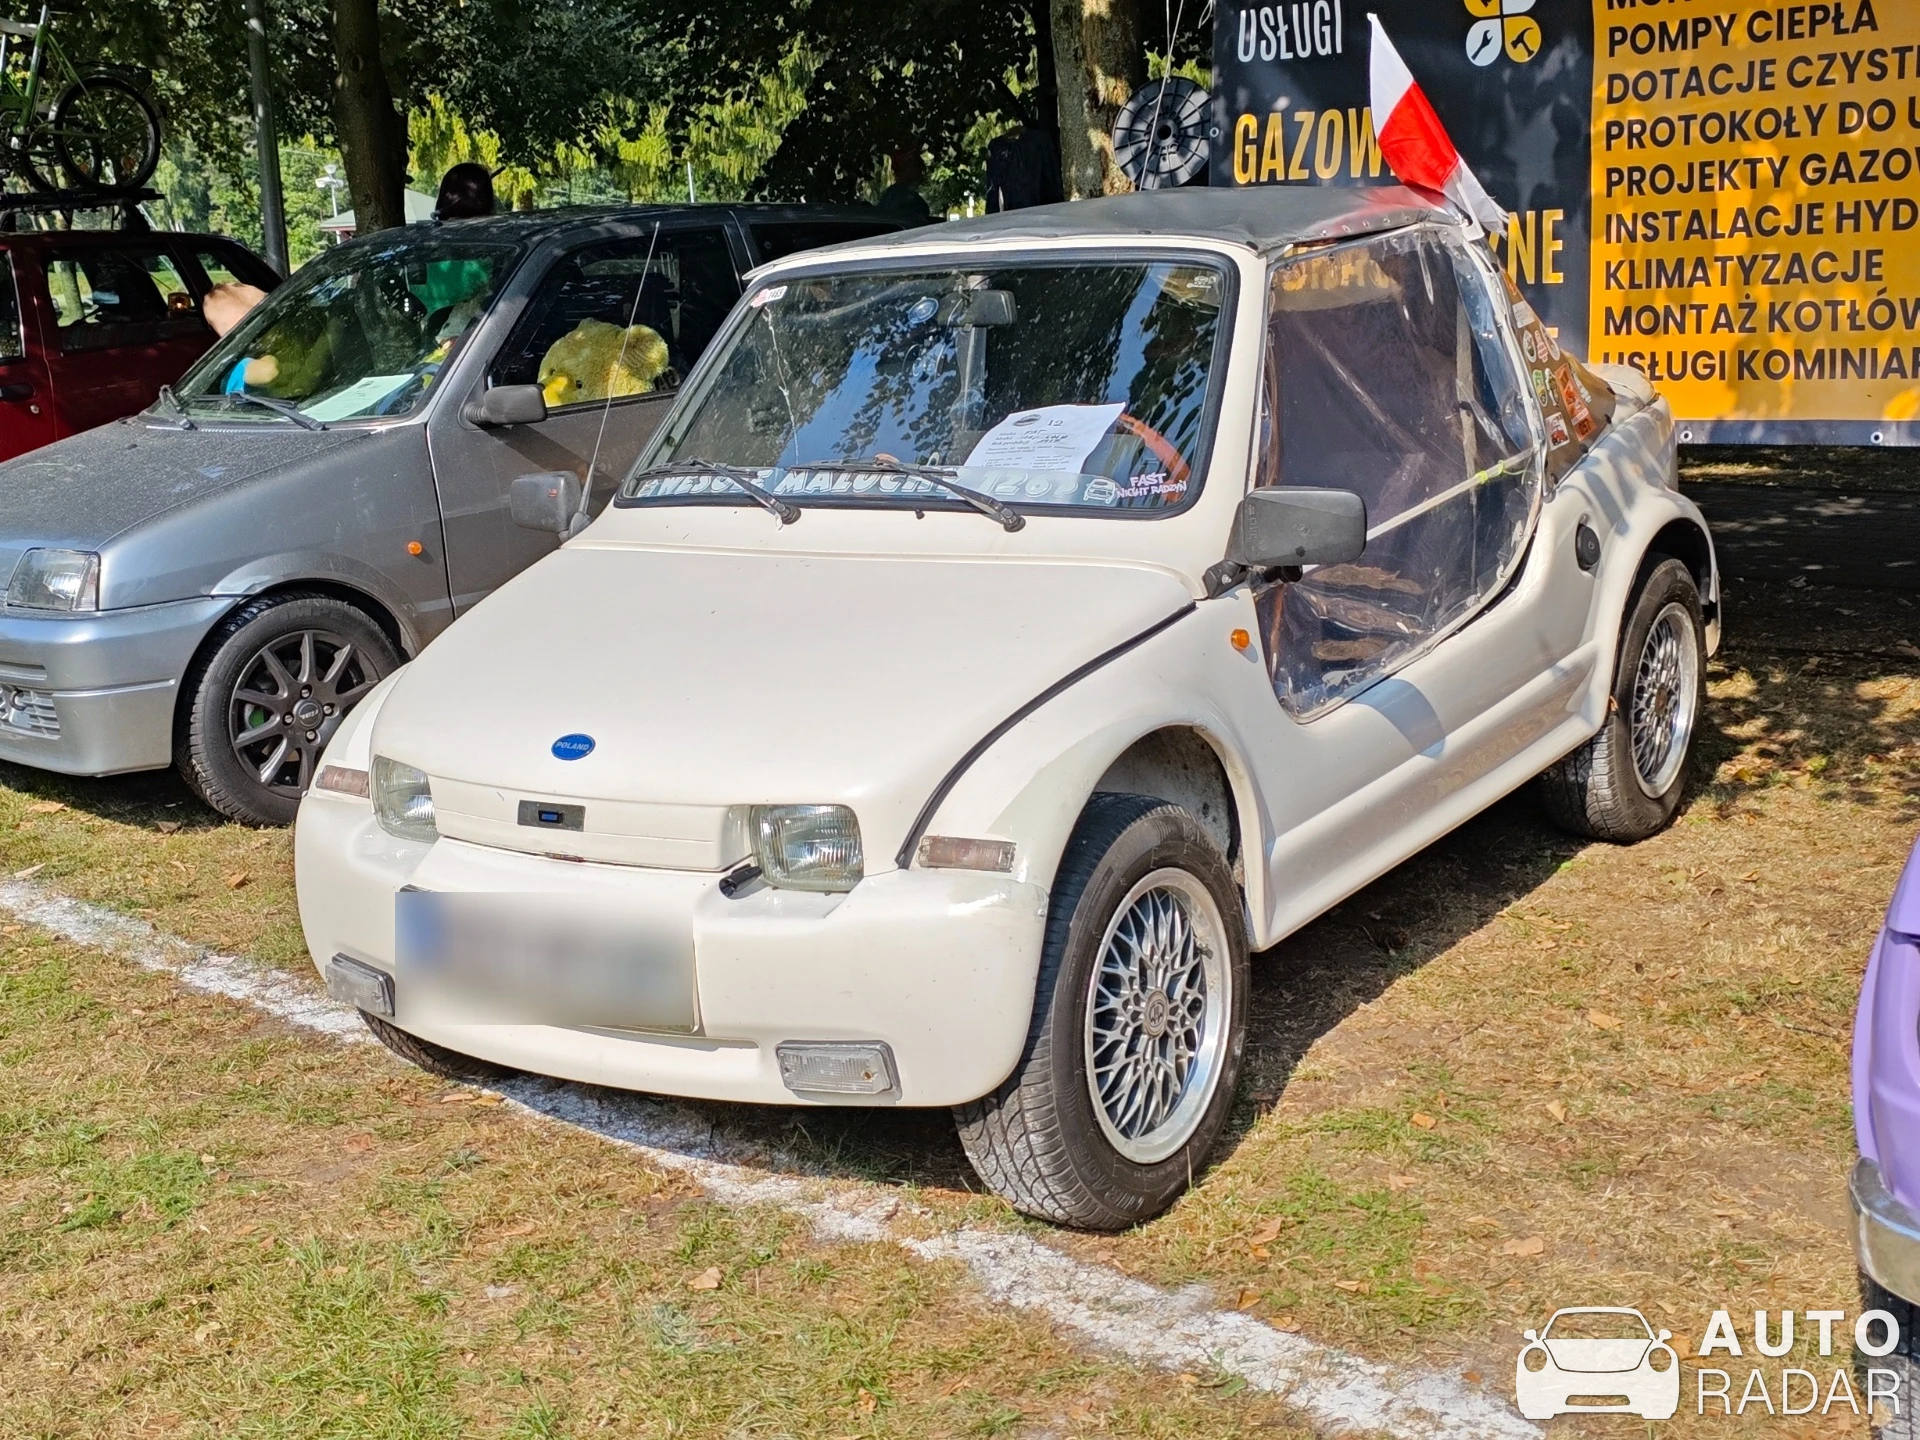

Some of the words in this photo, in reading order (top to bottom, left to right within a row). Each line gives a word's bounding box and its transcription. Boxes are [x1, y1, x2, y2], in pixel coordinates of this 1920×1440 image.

[1237, 0, 1342, 62] USŁUGI
[1608, 13, 1737, 58] POMPY
[1747, 0, 1878, 43] CIEPŁA
[1606, 59, 1777, 105] DOTACJE
[1786, 45, 1920, 89] CZYST
[1233, 106, 1396, 185] GAZOW
[1605, 103, 1828, 152] PROTOKOŁY
[1838, 98, 1896, 135] DO
[1605, 156, 1790, 198] PROJEKTY
[1799, 147, 1920, 186] GAZO
[1605, 202, 1825, 244] INSTALACJE
[1604, 249, 1884, 290] KLIMATYZACJE
[1604, 293, 1757, 336] MONTAŻ
[1116, 486, 1150, 498] NIGHT
[1151, 479, 1187, 494] RADZYŃ
[1130, 472, 1167, 487] FAST
[555, 741, 590, 751] POLAND
